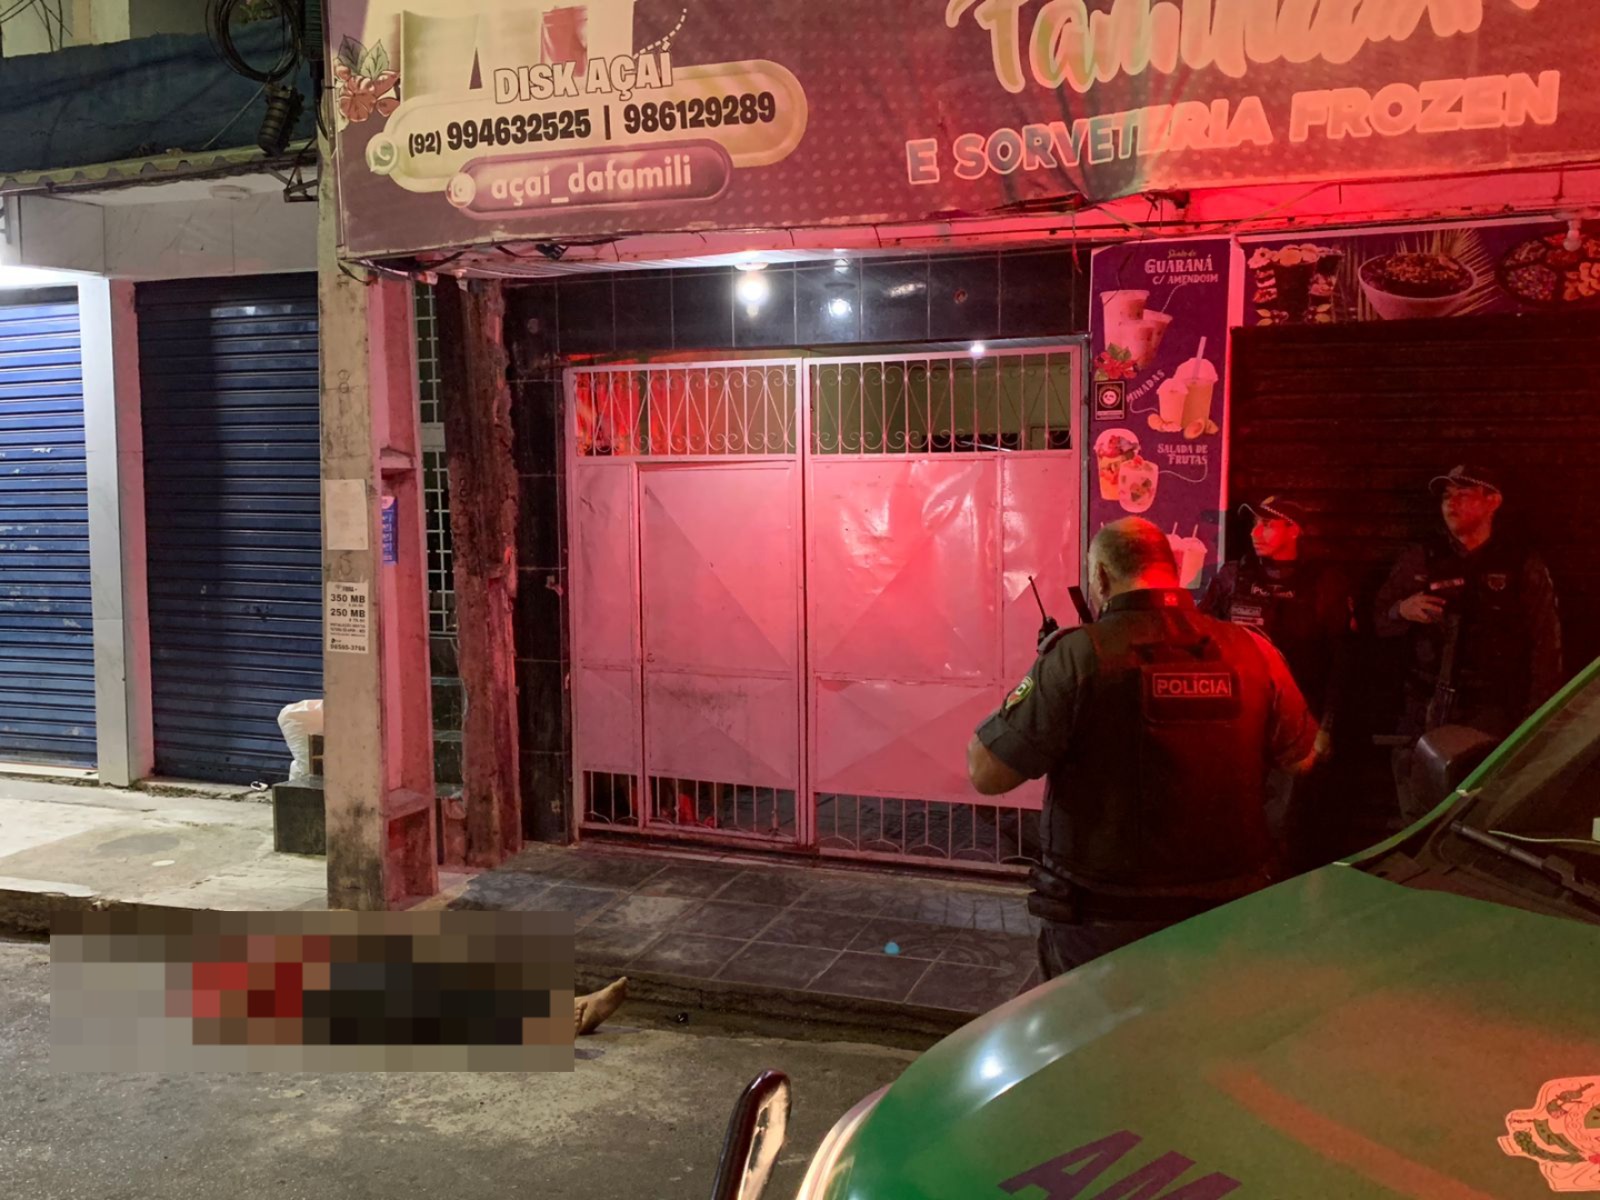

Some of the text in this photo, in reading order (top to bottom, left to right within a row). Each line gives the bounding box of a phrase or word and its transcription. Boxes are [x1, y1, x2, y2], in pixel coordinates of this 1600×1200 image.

[494, 39, 673, 104] DISK AÇAÍ
[408, 129, 443, 158] (92)
[447, 109, 591, 151] 994632525
[624, 92, 776, 134] 986129289
[906, 70, 1560, 185] E SORVETERIA FROZEN
[491, 156, 692, 206] açai_dafamili
[1144, 253, 1213, 274] GUARANÁ
[1167, 274, 1219, 284] AMENDOIM
[1157, 443, 1209, 454] SALADA DE
[1168, 453, 1208, 465] FRUTAS
[330, 593, 366, 604] 350 MB
[330, 608, 366, 618] 250 MB
[1156, 674, 1228, 695] POLÍCIA
